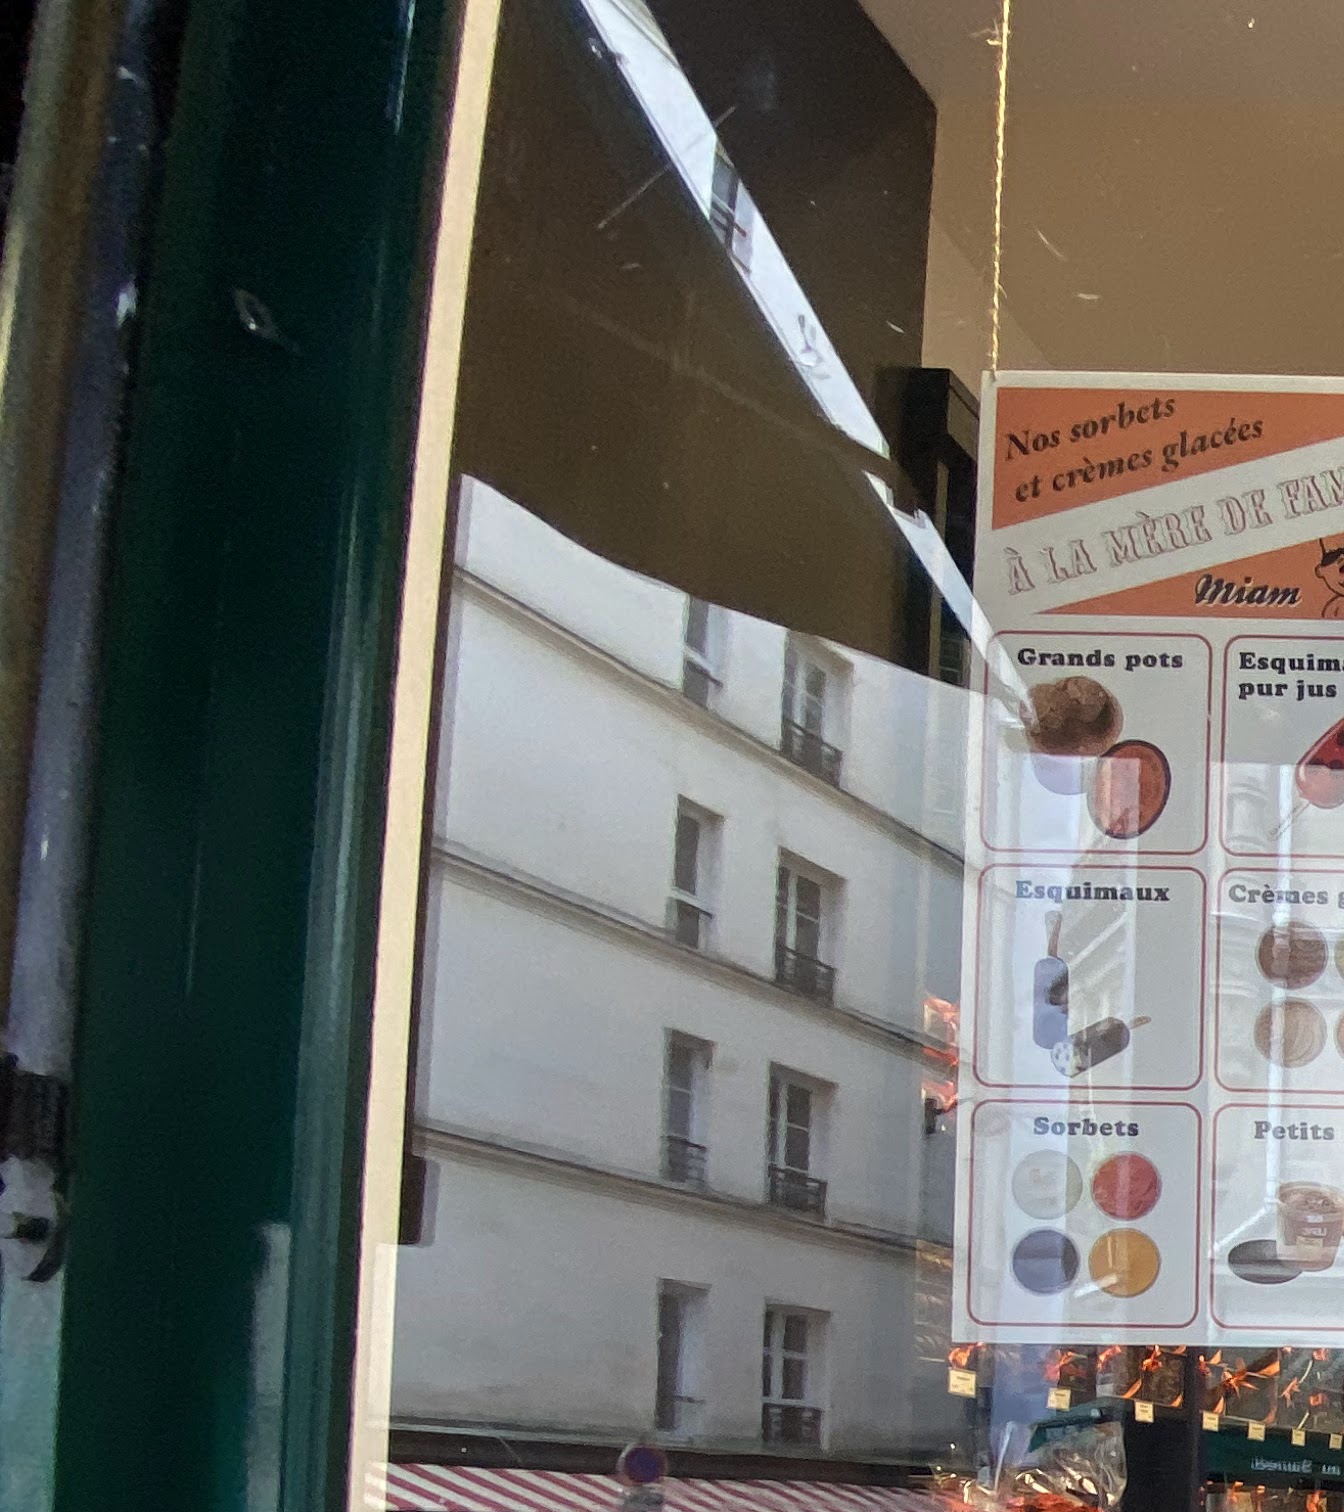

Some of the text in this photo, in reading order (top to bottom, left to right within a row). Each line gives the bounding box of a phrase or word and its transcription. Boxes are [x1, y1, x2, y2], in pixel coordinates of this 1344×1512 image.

[1005, 397, 1175, 461] Nos sorbets
[1015, 417, 1264, 502] et crèmes glacées
[1003, 545, 1035, 595] À
[1040, 539, 1098, 584] LA
[1101, 502, 1217, 567] MÈRE
[1217, 489, 1273, 536] DE
[1194, 574, 1302, 608] Miam
[1017, 648, 1184, 671] Grands pots
[1238, 679, 1337, 701] pur jus
[1015, 880, 1171, 904] Esquimaux
[1228, 883, 1329, 906] Crèmes
[1033, 1117, 1139, 1137] Sorbets
[1253, 1120, 1335, 1141] Petits
